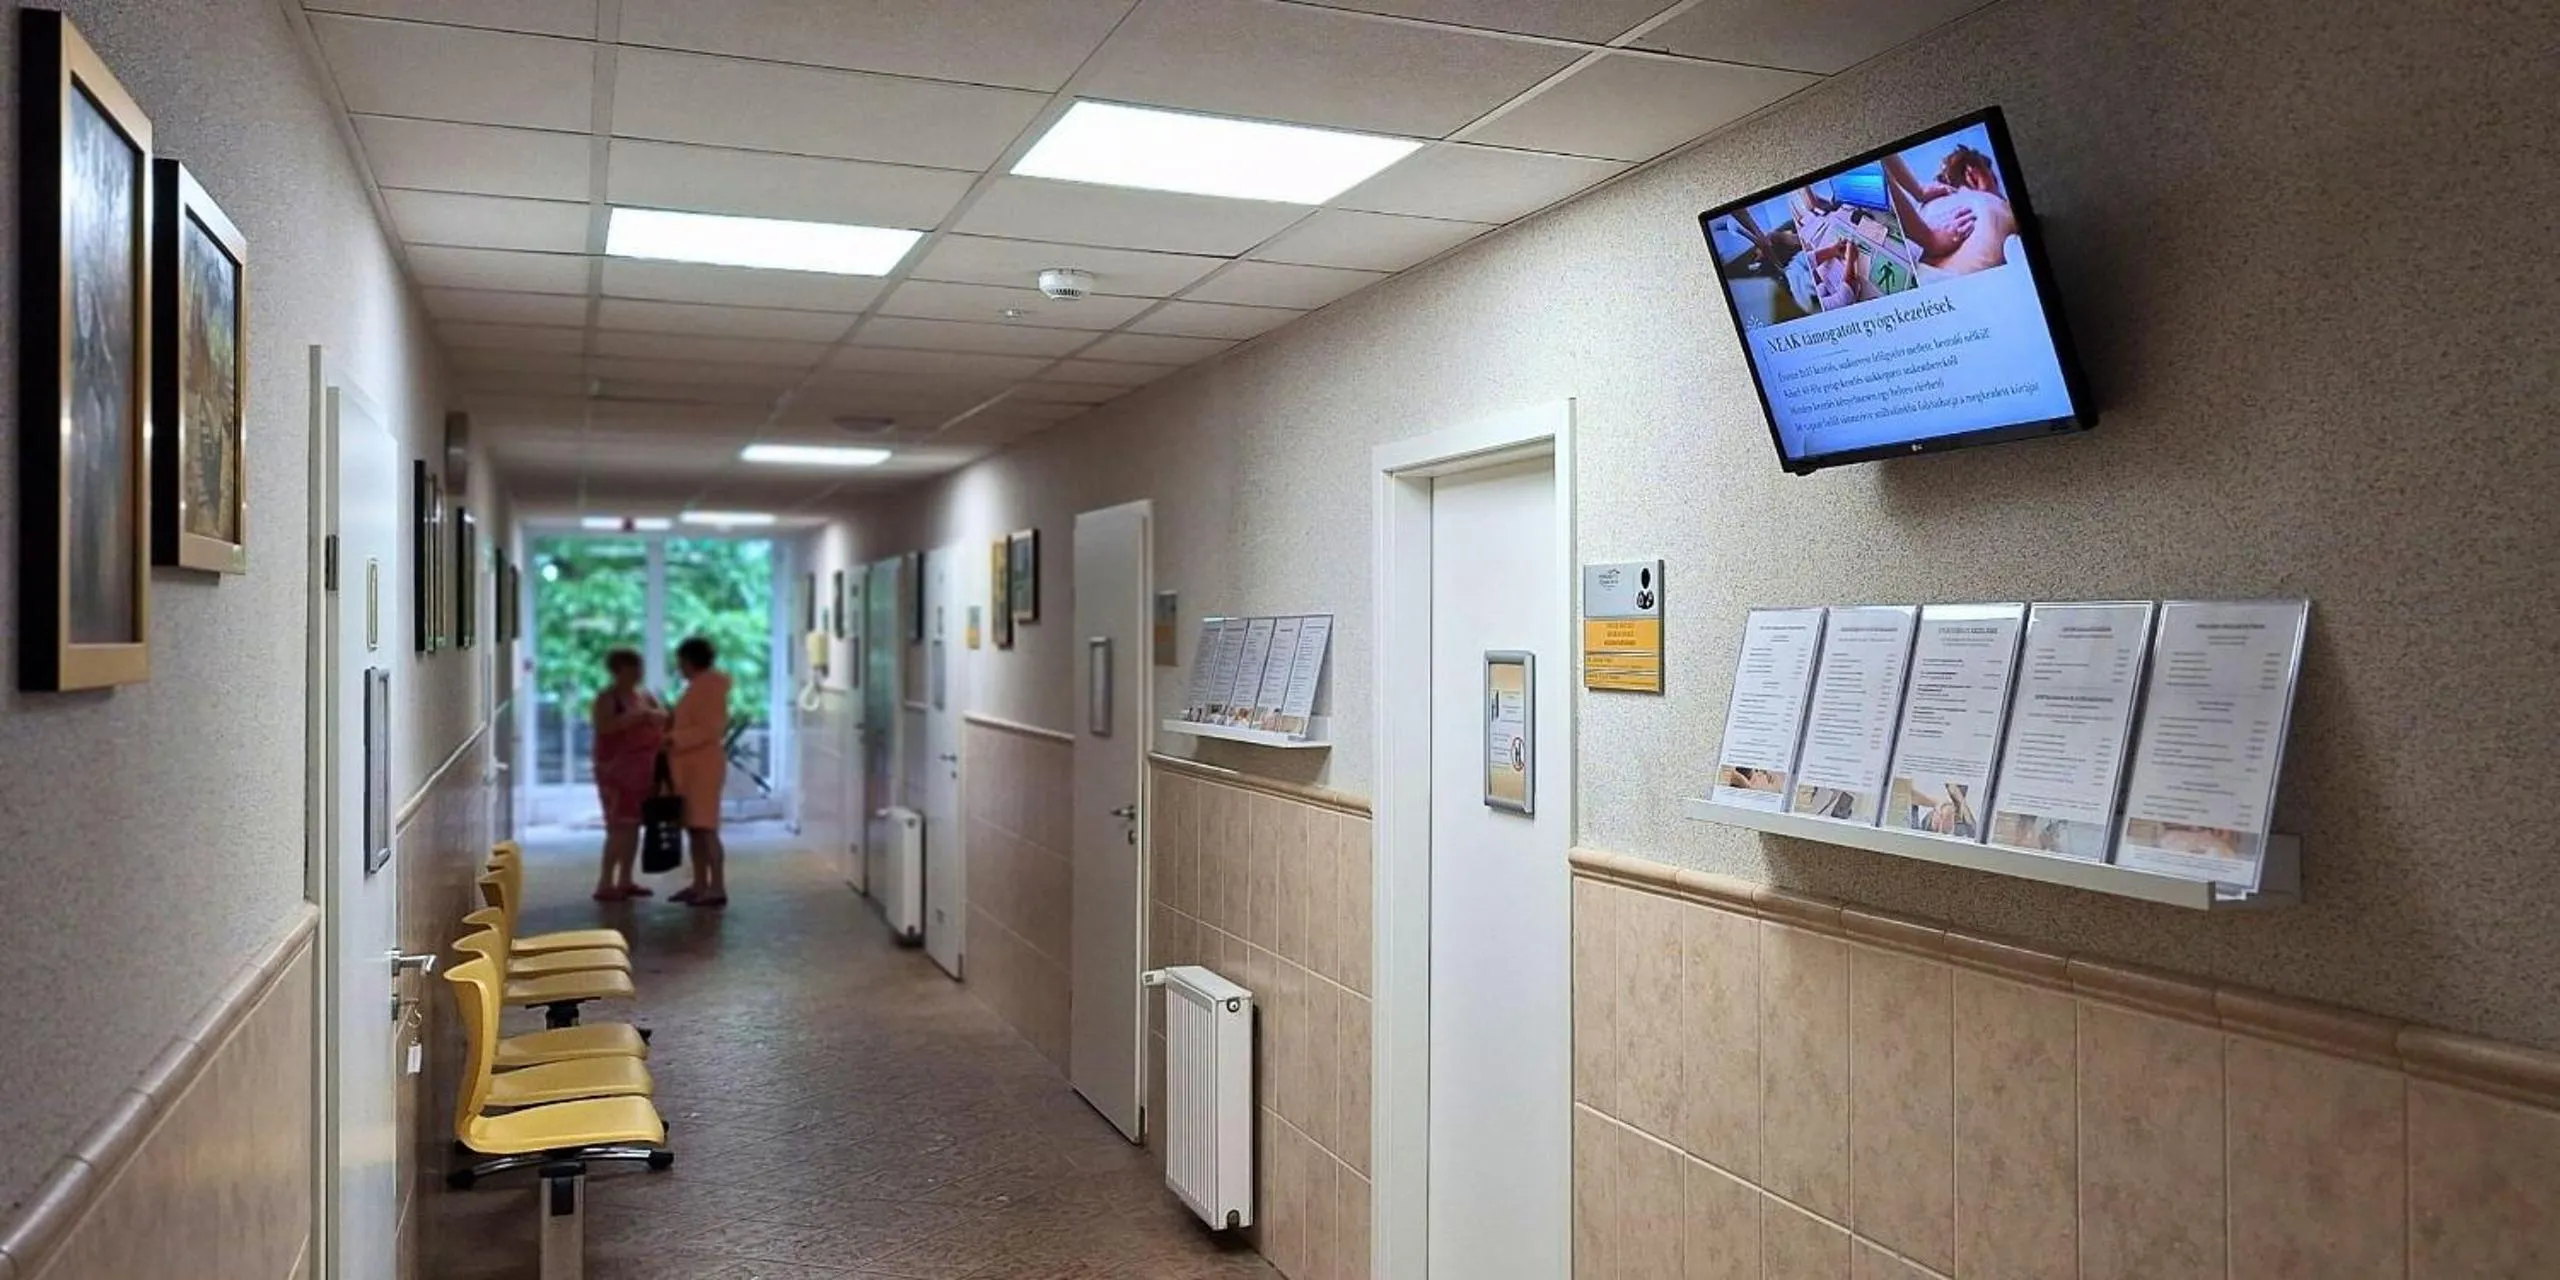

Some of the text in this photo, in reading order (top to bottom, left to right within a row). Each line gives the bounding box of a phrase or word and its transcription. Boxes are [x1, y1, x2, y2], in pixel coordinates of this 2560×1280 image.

[1767, 295, 1956, 354] NEAK támogatott gyógykezelések
